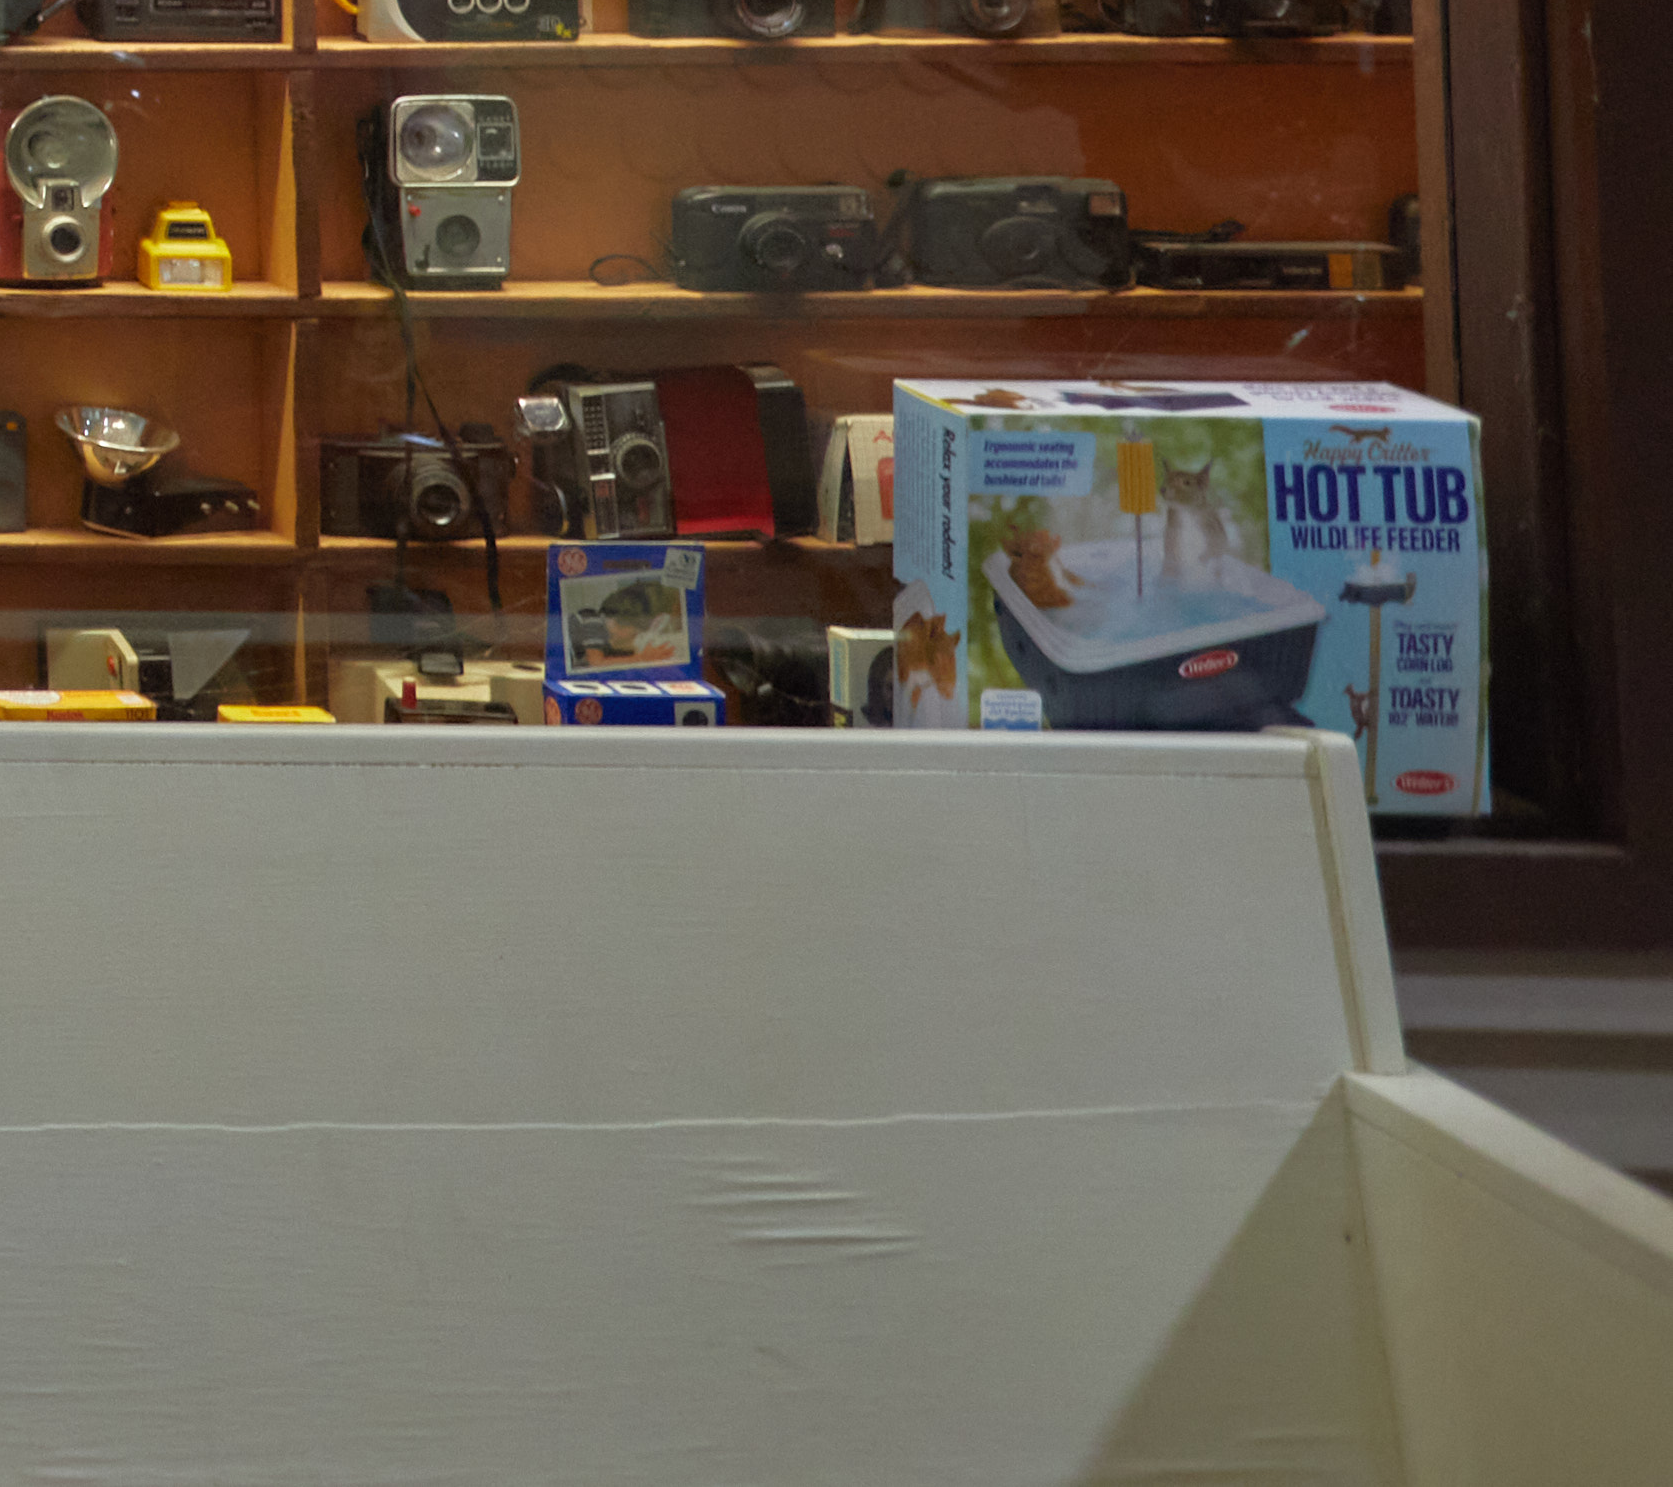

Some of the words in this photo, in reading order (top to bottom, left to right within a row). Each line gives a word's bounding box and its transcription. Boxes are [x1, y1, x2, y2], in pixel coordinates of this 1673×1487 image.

[1302, 439, 1362, 465] Happy
[1365, 439, 1431, 462] Critter
[1273, 463, 1366, 524] HOT
[1374, 465, 1468, 525] TUB
[1290, 525, 1382, 553] WILDLIFE
[1386, 525, 1460, 553] FEEDER
[1395, 632, 1455, 657] TASTY
[1395, 658, 1427, 673] CORN
[1388, 687, 1461, 712] TOASTY
